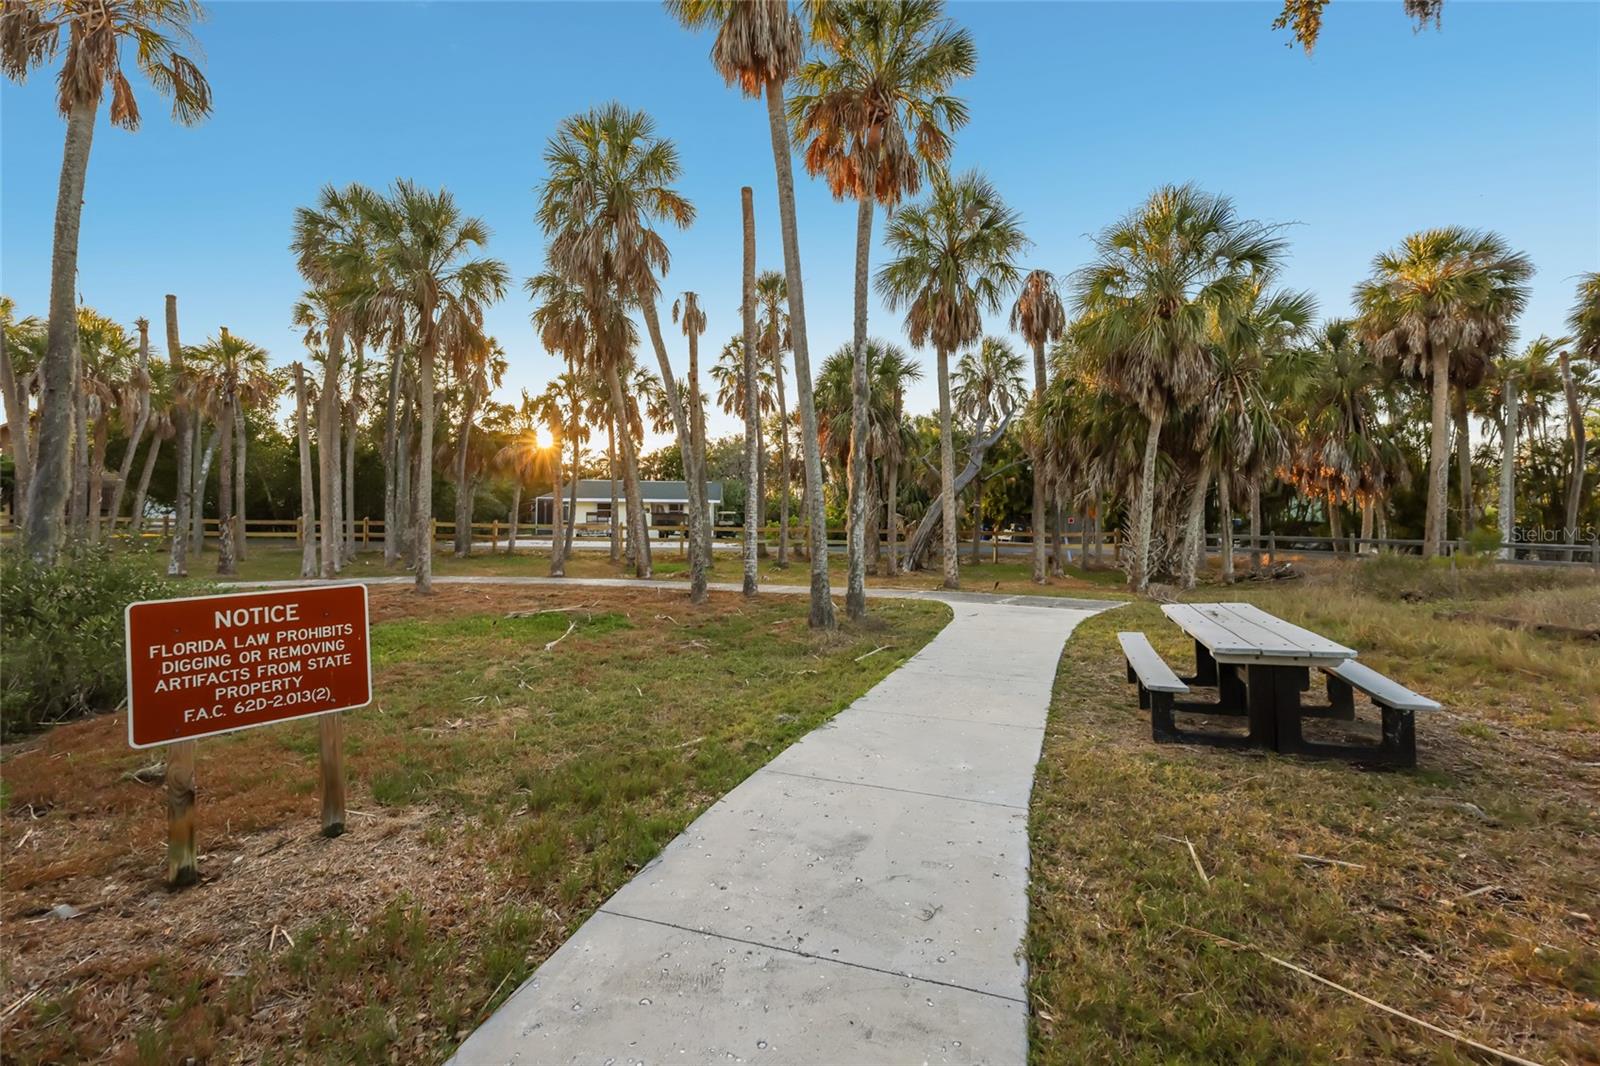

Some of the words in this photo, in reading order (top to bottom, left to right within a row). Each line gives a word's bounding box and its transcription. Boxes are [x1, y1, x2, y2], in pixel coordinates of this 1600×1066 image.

[215, 604, 299, 629] NOTICE
[149, 638, 226, 659] FLORIDA
[234, 633, 269, 649] LAW
[276, 623, 353, 643] PROHIBITS
[162, 654, 231, 675] DIGGING
[239, 650, 261, 664] OR
[268, 639, 345, 660] REMOVING
[154, 668, 250, 693] ARTIFACTS
[257, 661, 301, 678] FROM
[308, 653, 352, 671] STATE
[215, 675, 303, 700] PROPERTY
